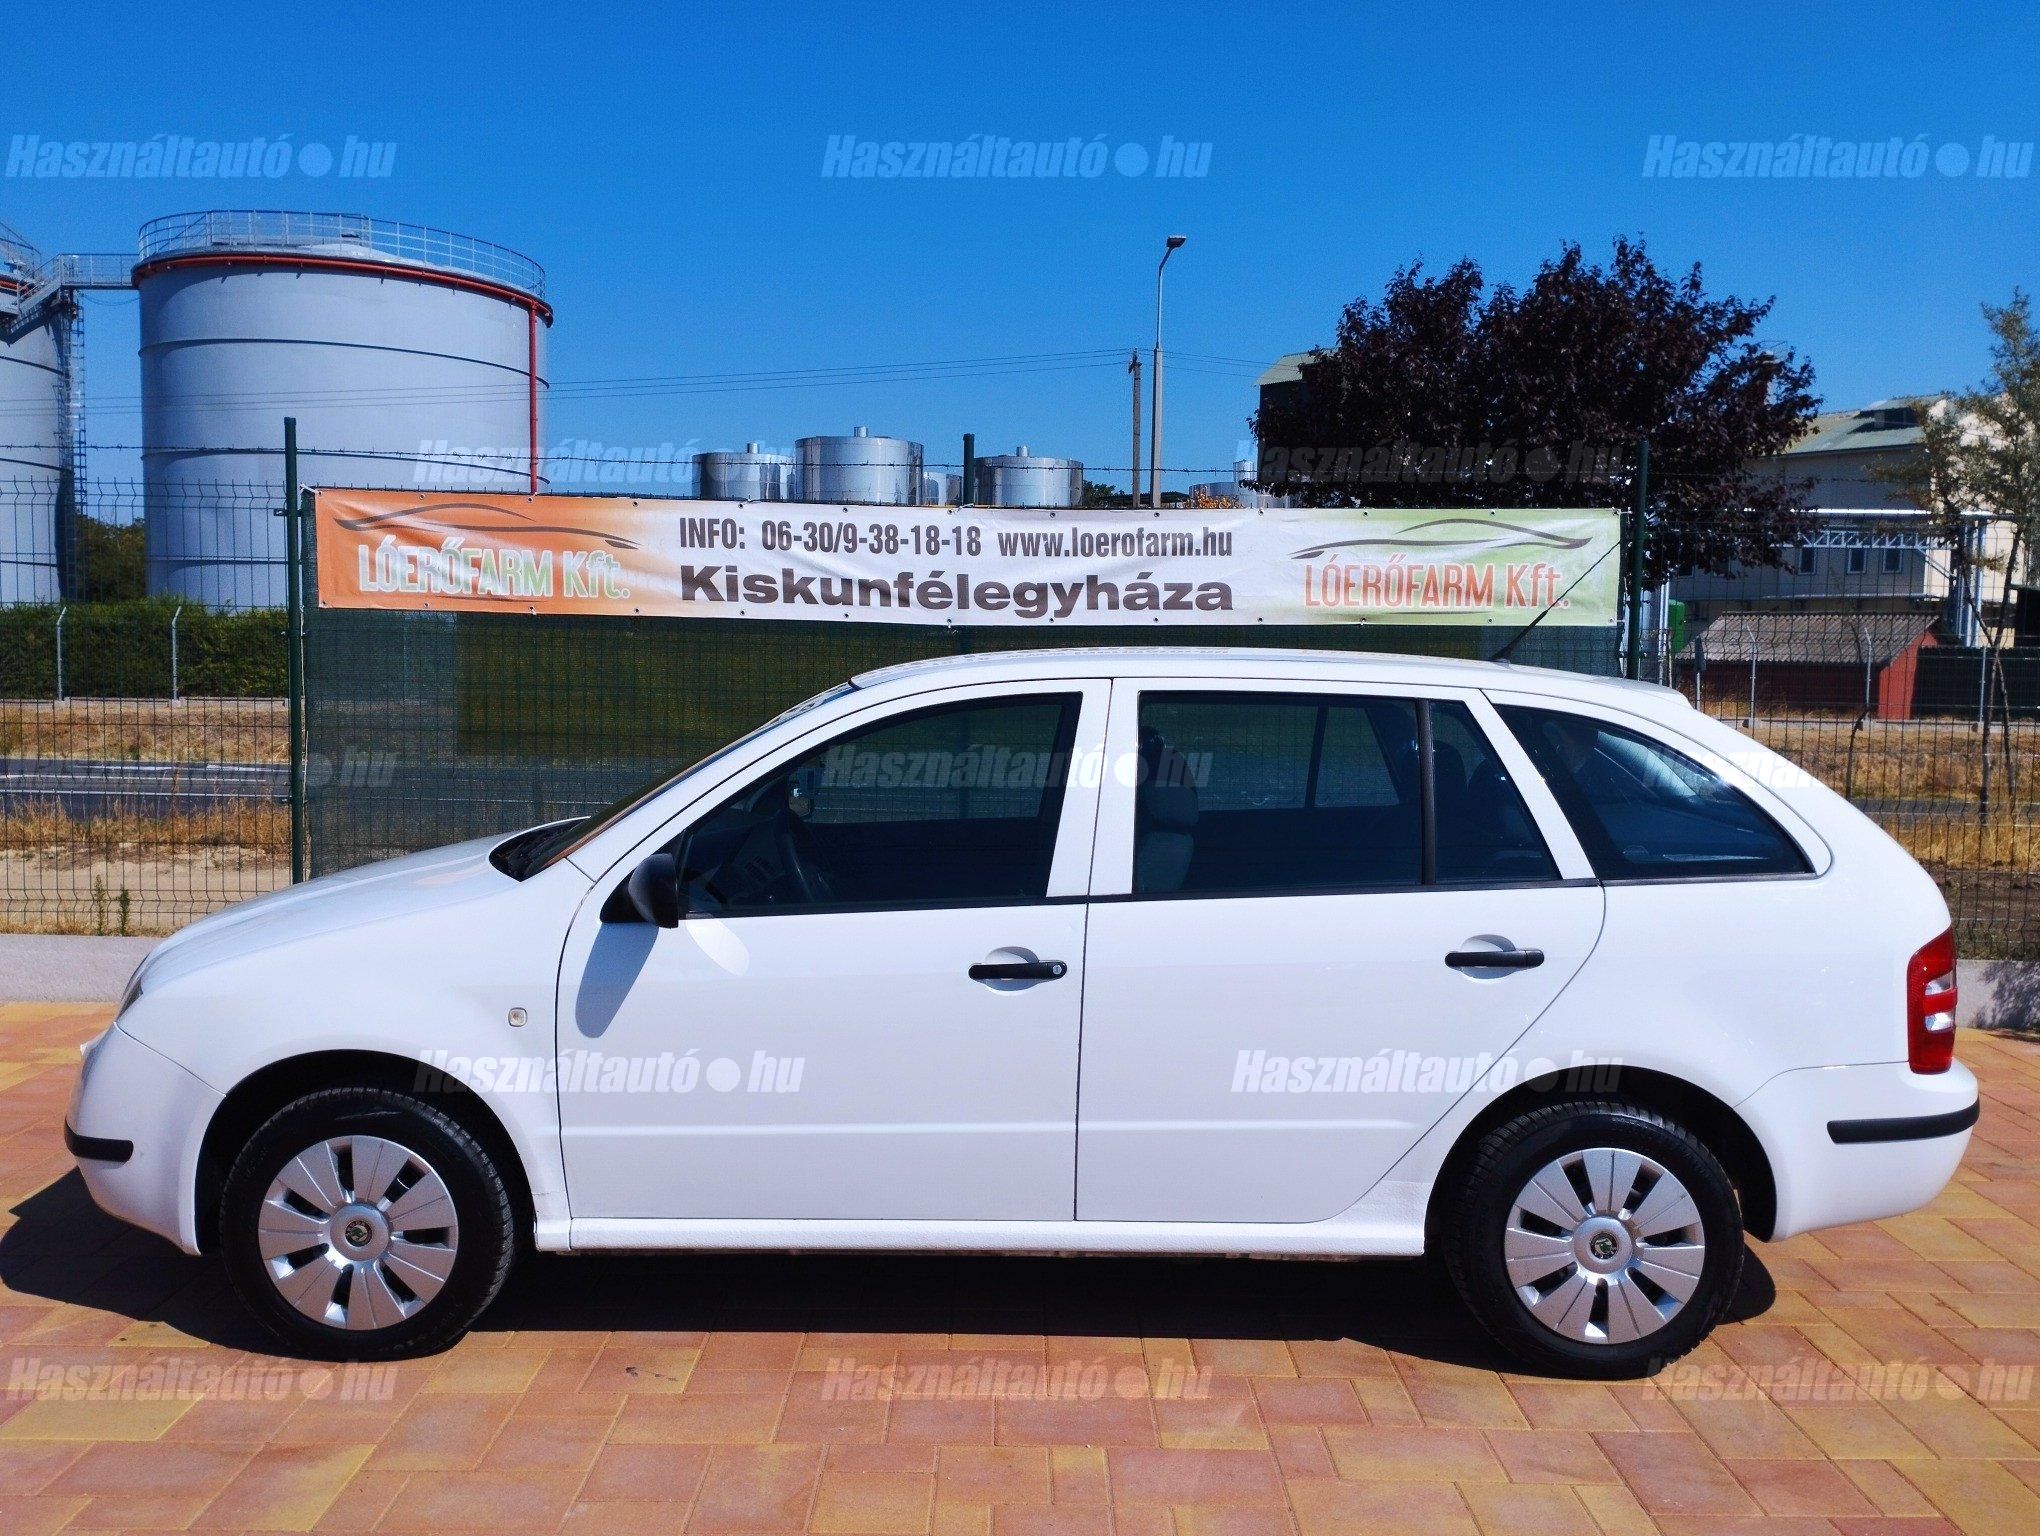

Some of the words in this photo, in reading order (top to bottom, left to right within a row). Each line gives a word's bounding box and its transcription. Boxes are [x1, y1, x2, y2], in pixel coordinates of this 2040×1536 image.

[680, 517, 746, 549] INFO:
[761, 519, 982, 557] 06-30/9-38-18-18
[997, 526, 1232, 557] www.loerofarm.hu
[358, 535, 553, 597] LÓERŐFARM
[562, 550, 631, 599] Kft.
[680, 564, 1233, 618] Kiskunfélegyháza
[1304, 553, 1495, 609] LÓERŐFARM
[1504, 563, 1572, 609] Kft.
